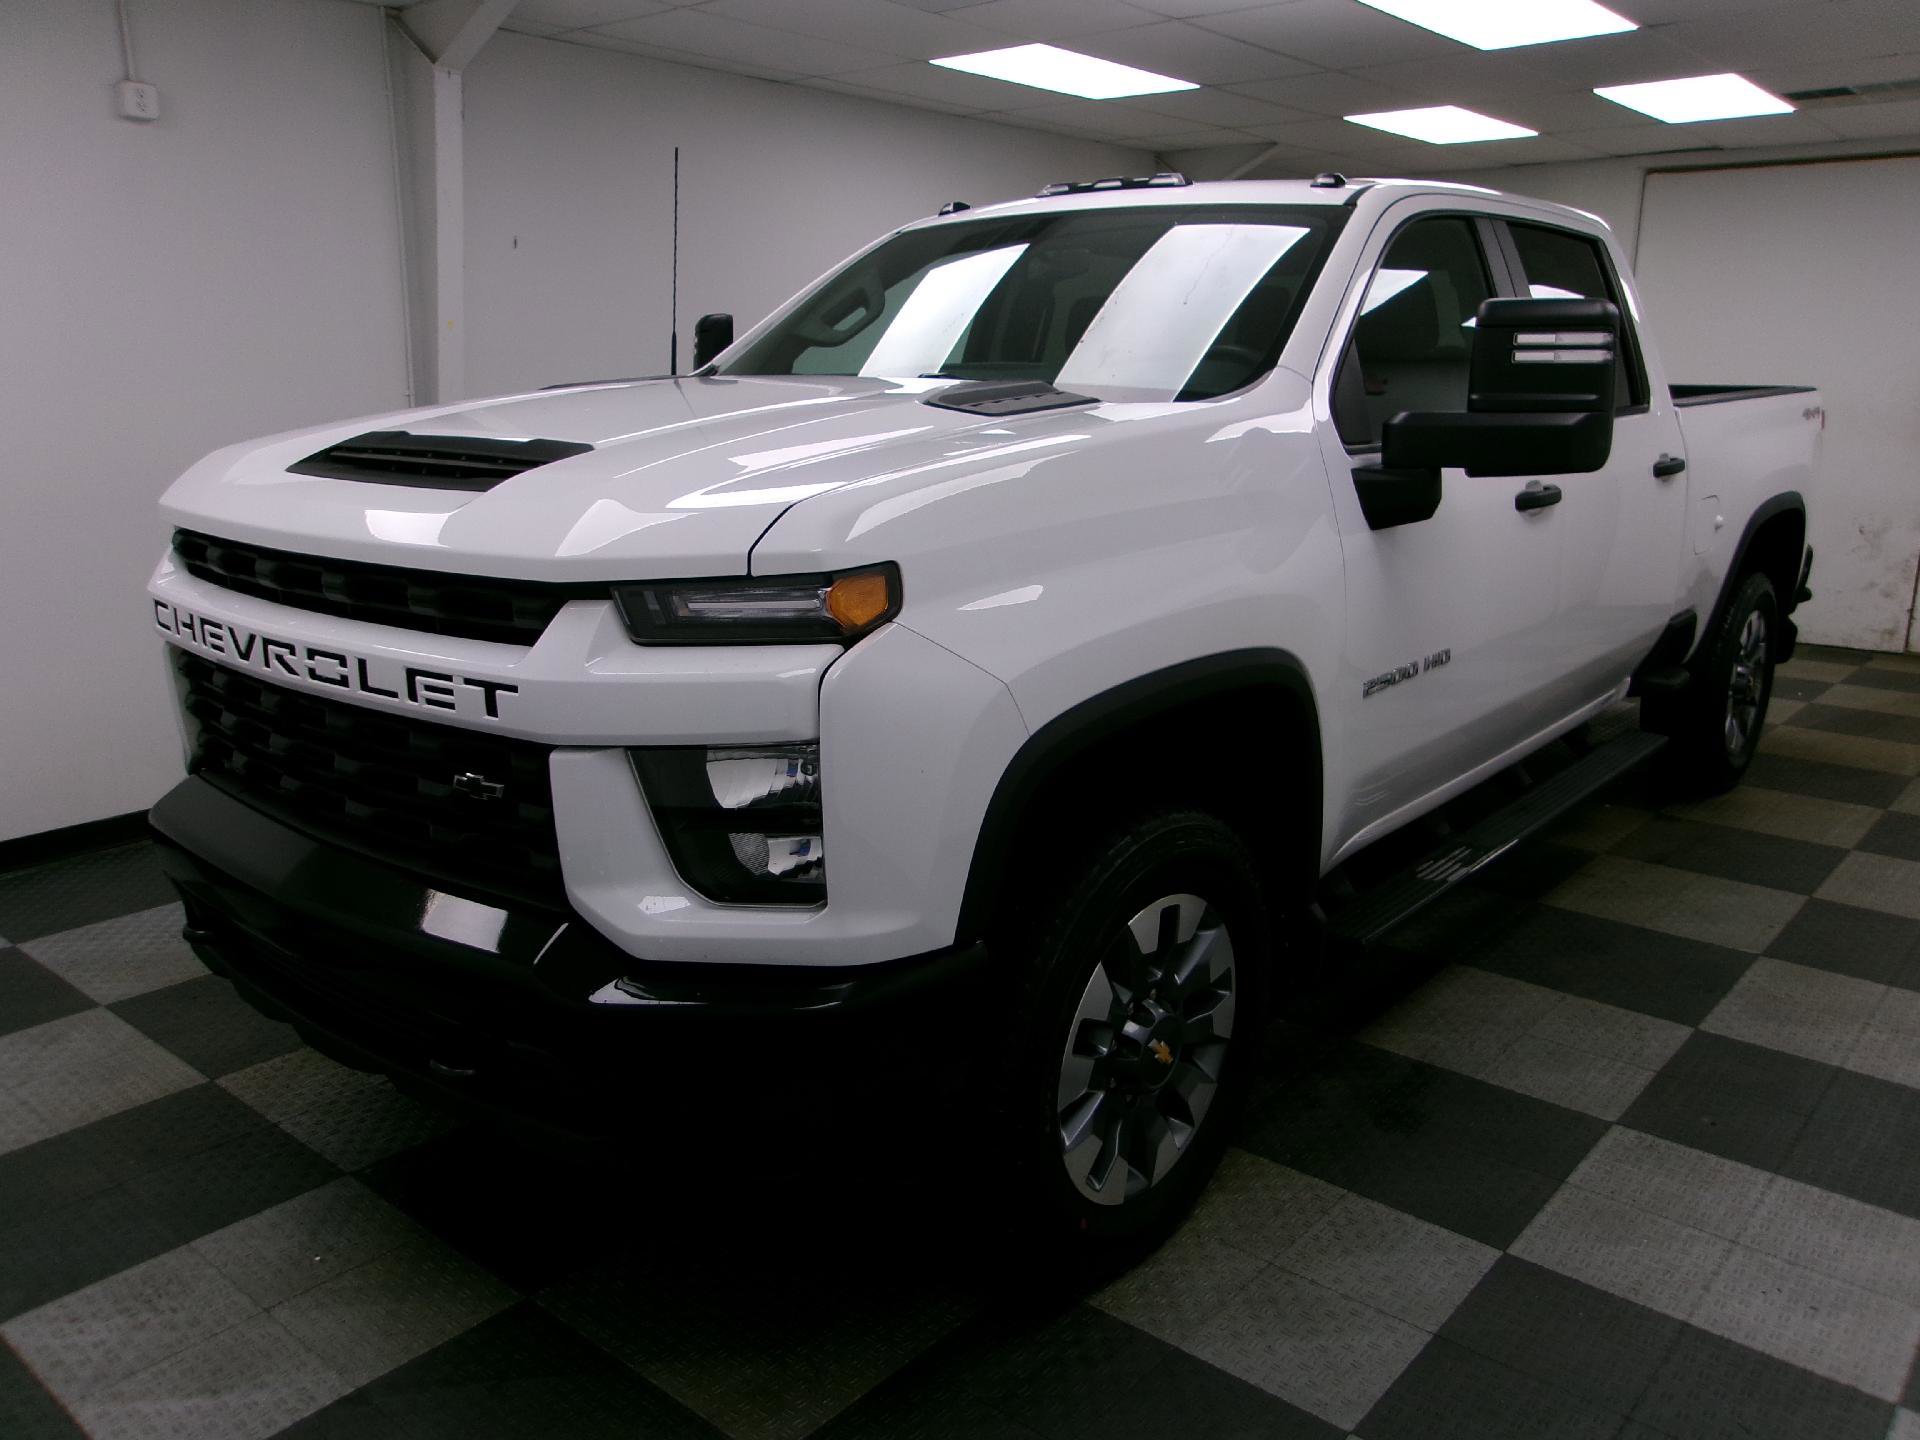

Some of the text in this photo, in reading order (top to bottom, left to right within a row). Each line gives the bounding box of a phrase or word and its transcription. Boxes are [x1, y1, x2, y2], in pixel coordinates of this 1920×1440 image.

[154, 599, 519, 719] CHEVROLET
[1362, 648, 1451, 699] 2500 HD
